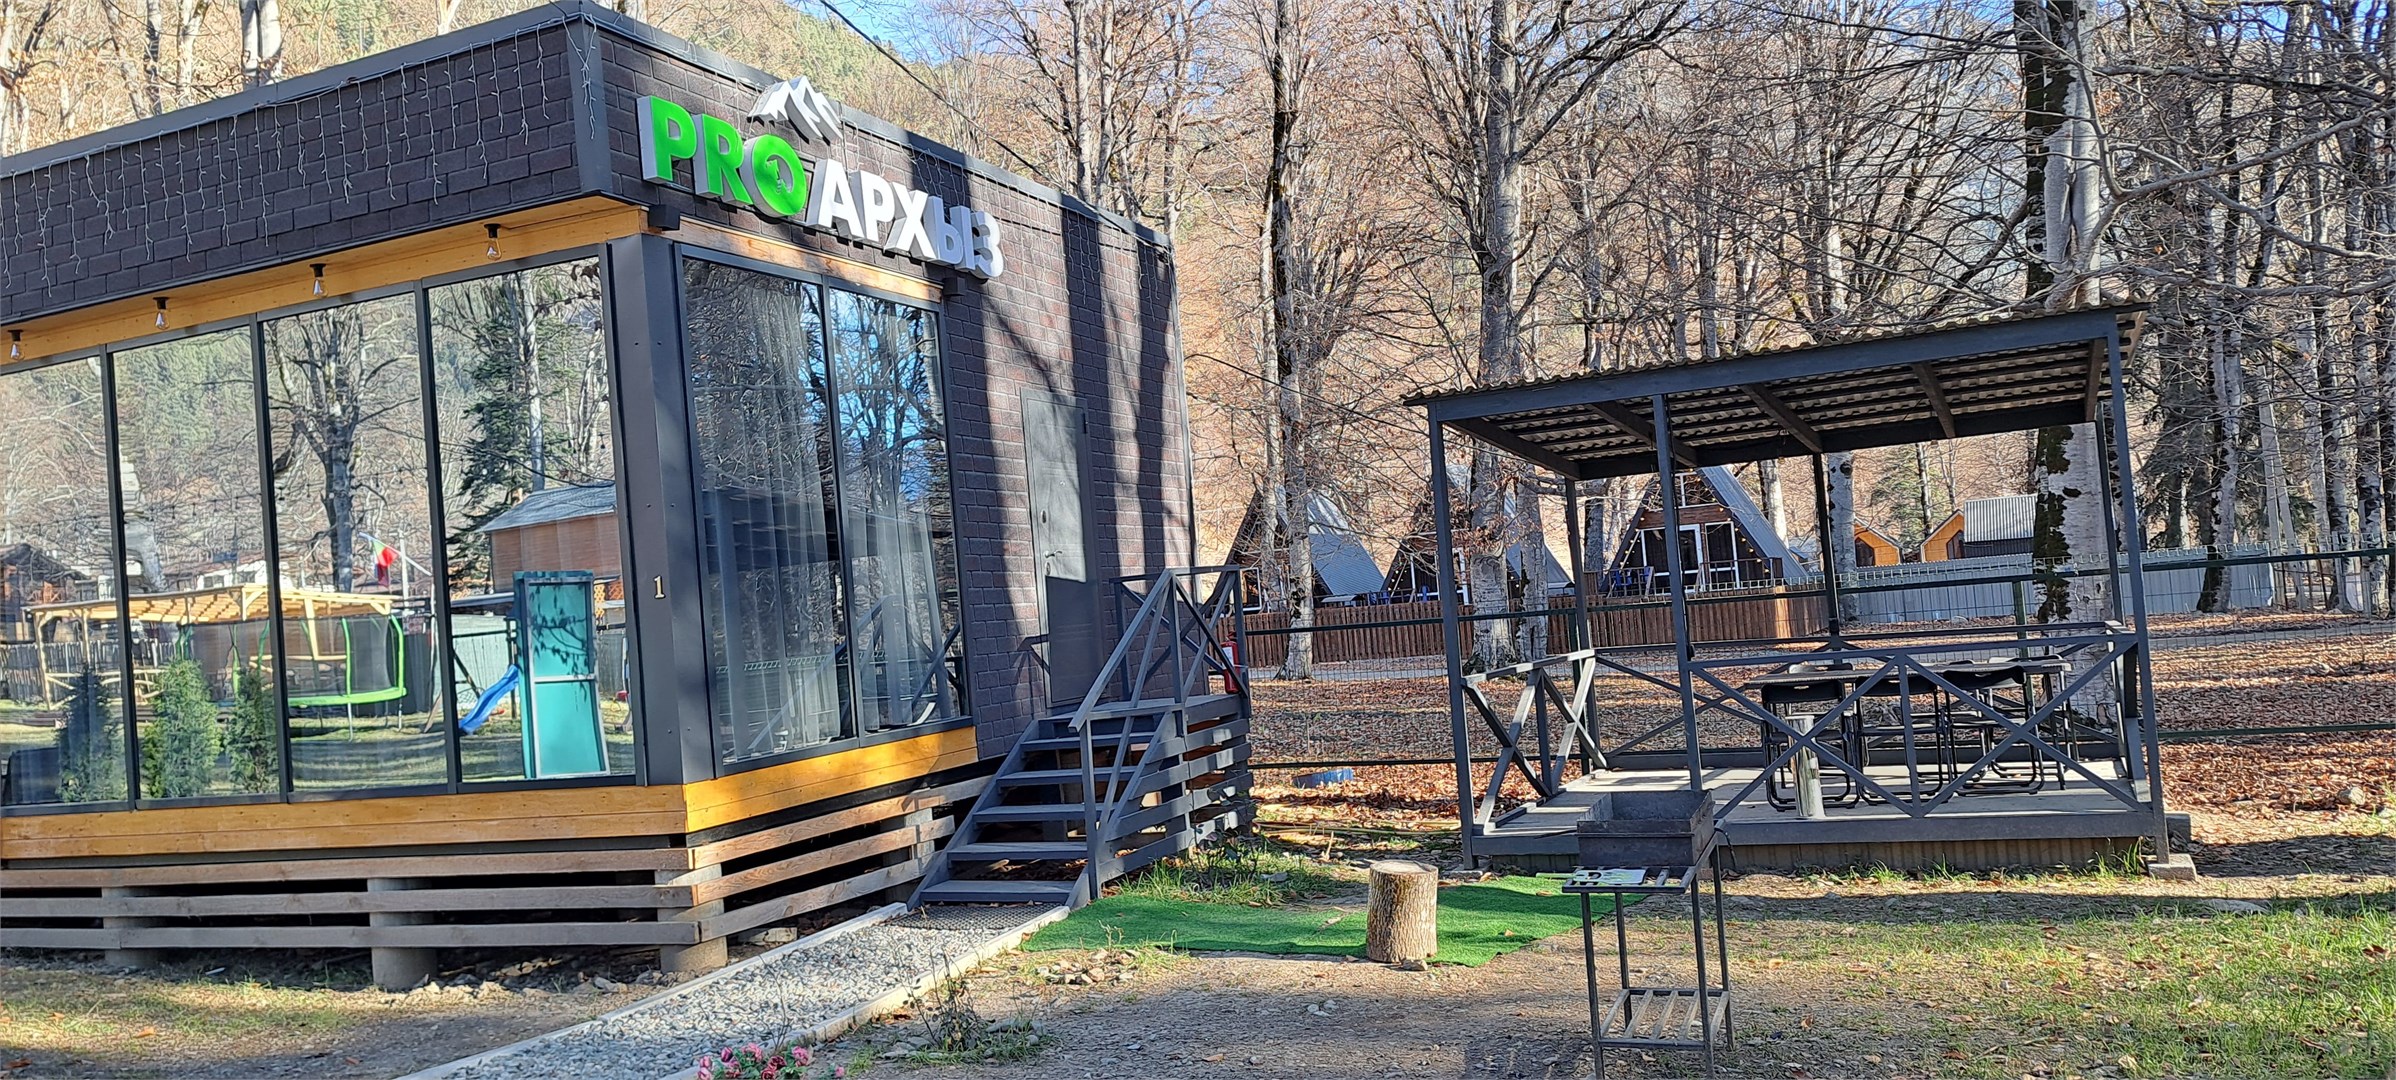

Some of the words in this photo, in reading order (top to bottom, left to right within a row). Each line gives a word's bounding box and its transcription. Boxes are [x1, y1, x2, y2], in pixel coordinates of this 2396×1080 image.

[639, 95, 806, 217] PRO
[806, 159, 1003, 278] АРХЫЗ
[654, 575, 665, 598] 1
